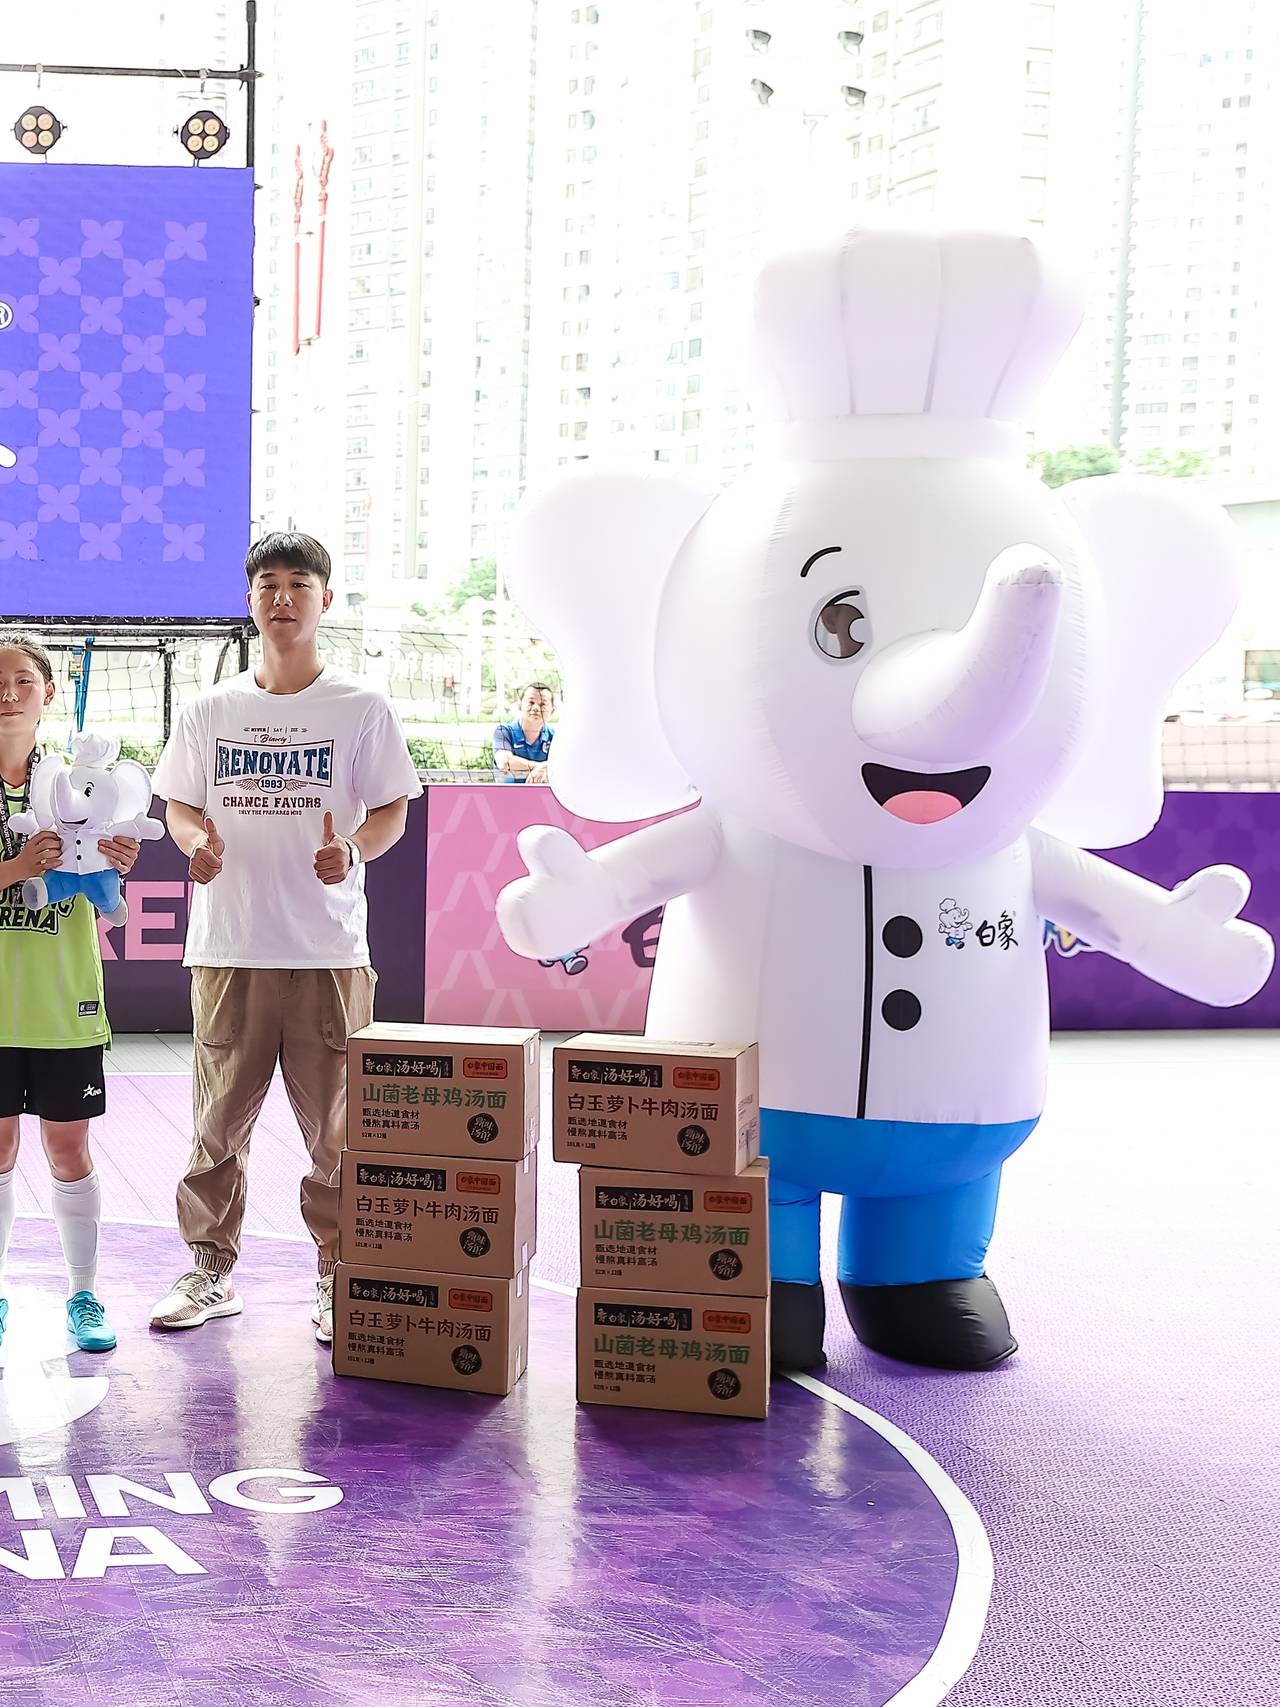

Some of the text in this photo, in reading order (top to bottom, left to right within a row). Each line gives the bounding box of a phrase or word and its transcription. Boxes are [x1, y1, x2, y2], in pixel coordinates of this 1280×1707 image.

[218, 746, 331, 780] RENOVATE
[223, 796, 322, 808] CHANCE FAVORS
[1, 821, 10, 838] YOUR
[4, 838, 13, 855] PITCH
[975, 910, 1019, 951] 白象
[396, 1060, 439, 1076] 汤好喝
[604, 1067, 650, 1085] 汤好喝
[362, 1084, 508, 1109] 山菌老母鸡汤面
[567, 1093, 720, 1121] 白玉萝卜牛肉汤面
[390, 1171, 433, 1188] 汤好喝
[355, 1195, 500, 1224] 白玉萝卜牛肉汤面
[632, 1193, 679, 1210] 汤好喝
[594, 1219, 751, 1246] 山菌老母鸡汤面
[382, 1286, 426, 1305] 汤好喝
[349, 1310, 493, 1342] 白玉萝卜牛肉汤面
[631, 1310, 678, 1328] 汤好喝
[593, 1334, 751, 1365] 山菌老母鸡汤面
